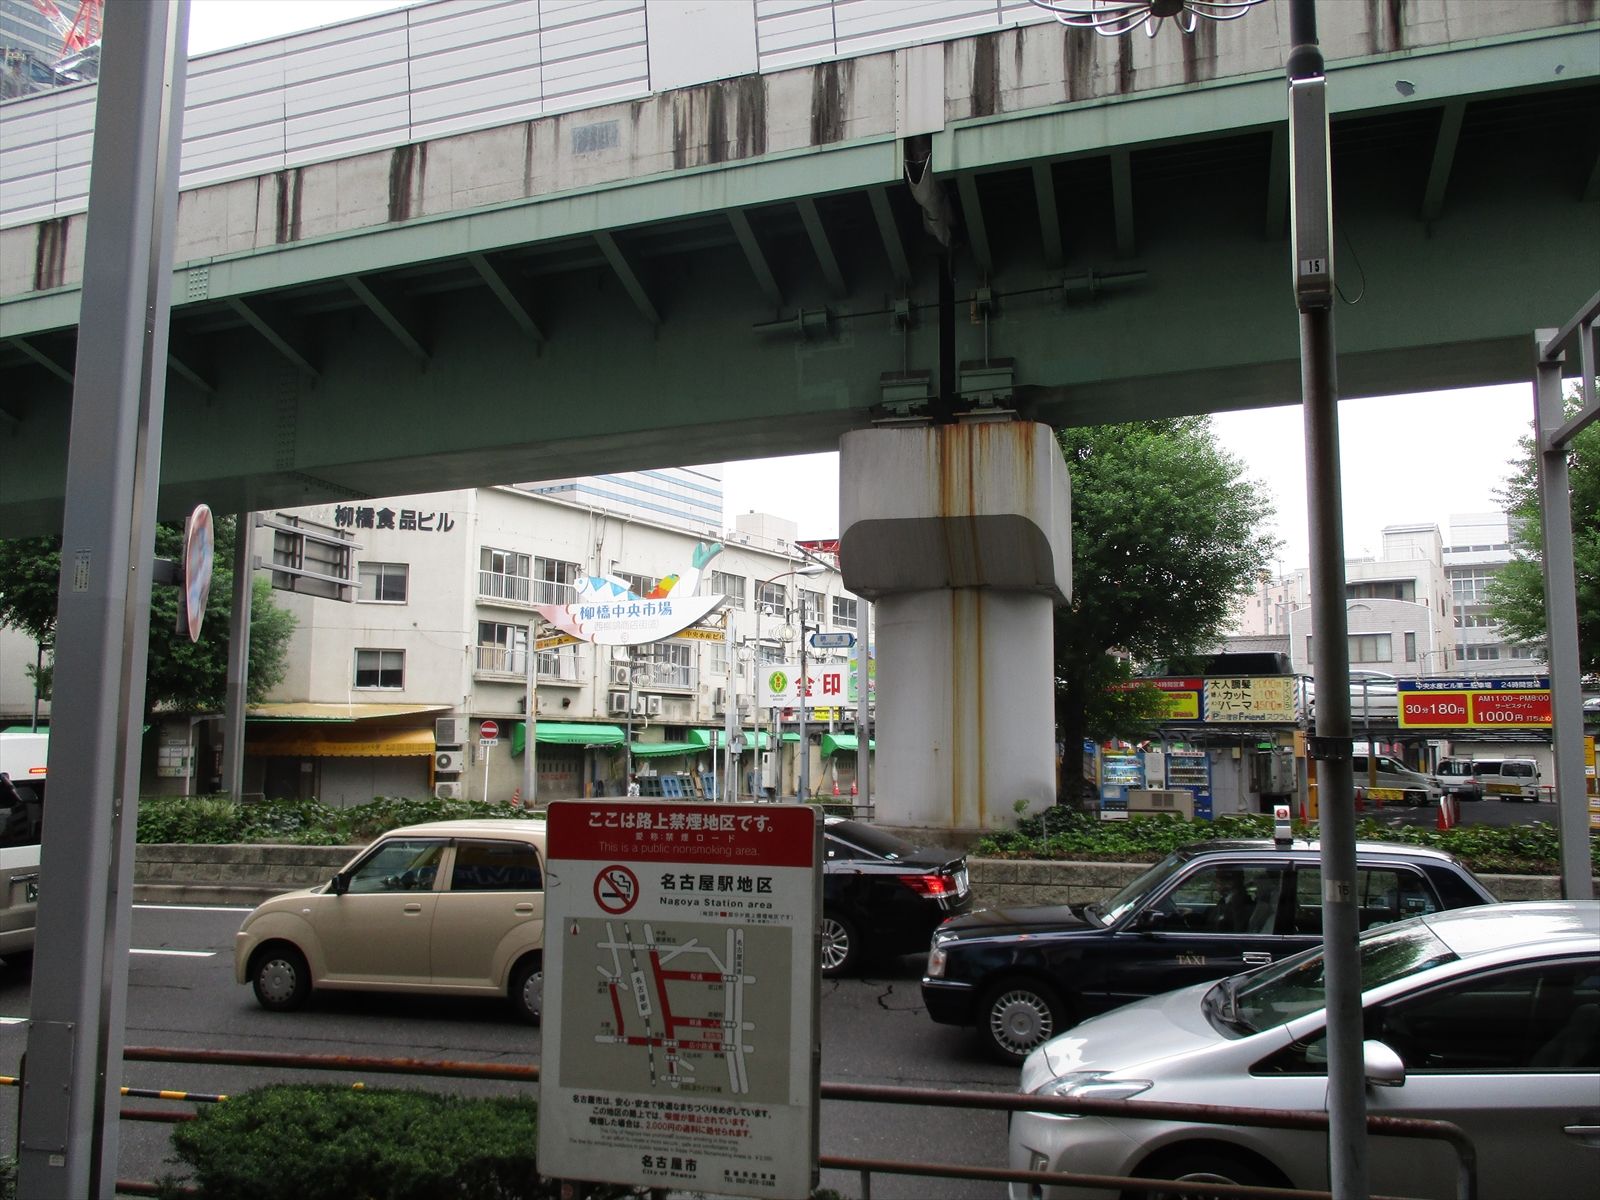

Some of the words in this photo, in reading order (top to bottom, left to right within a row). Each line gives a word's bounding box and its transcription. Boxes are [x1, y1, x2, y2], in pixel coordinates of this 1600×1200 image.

[1309, 260, 1320, 273] 15
[334, 504, 455, 533] 柳橋食品ビル
[579, 601, 673, 621] 柳橋中央市場
[1478, 711, 1524, 722] 1000円
[588, 811, 774, 834] ここは路上禁煙地区です。
[600, 841, 617, 853] This
[621, 843, 629, 853] is
[631, 845, 638, 853] a
[641, 843, 669, 856] public
[672, 844, 732, 857] nonsmoking
[735, 847, 760, 856] area.
[660, 872, 773, 893] 名古屋駅地区
[659, 896, 700, 908] Nagoya
[704, 898, 744, 908] Station
[747, 901, 773, 909] area
[1176, 955, 1206, 966] TAXI
[641, 1154, 697, 1172] 名古屋市
